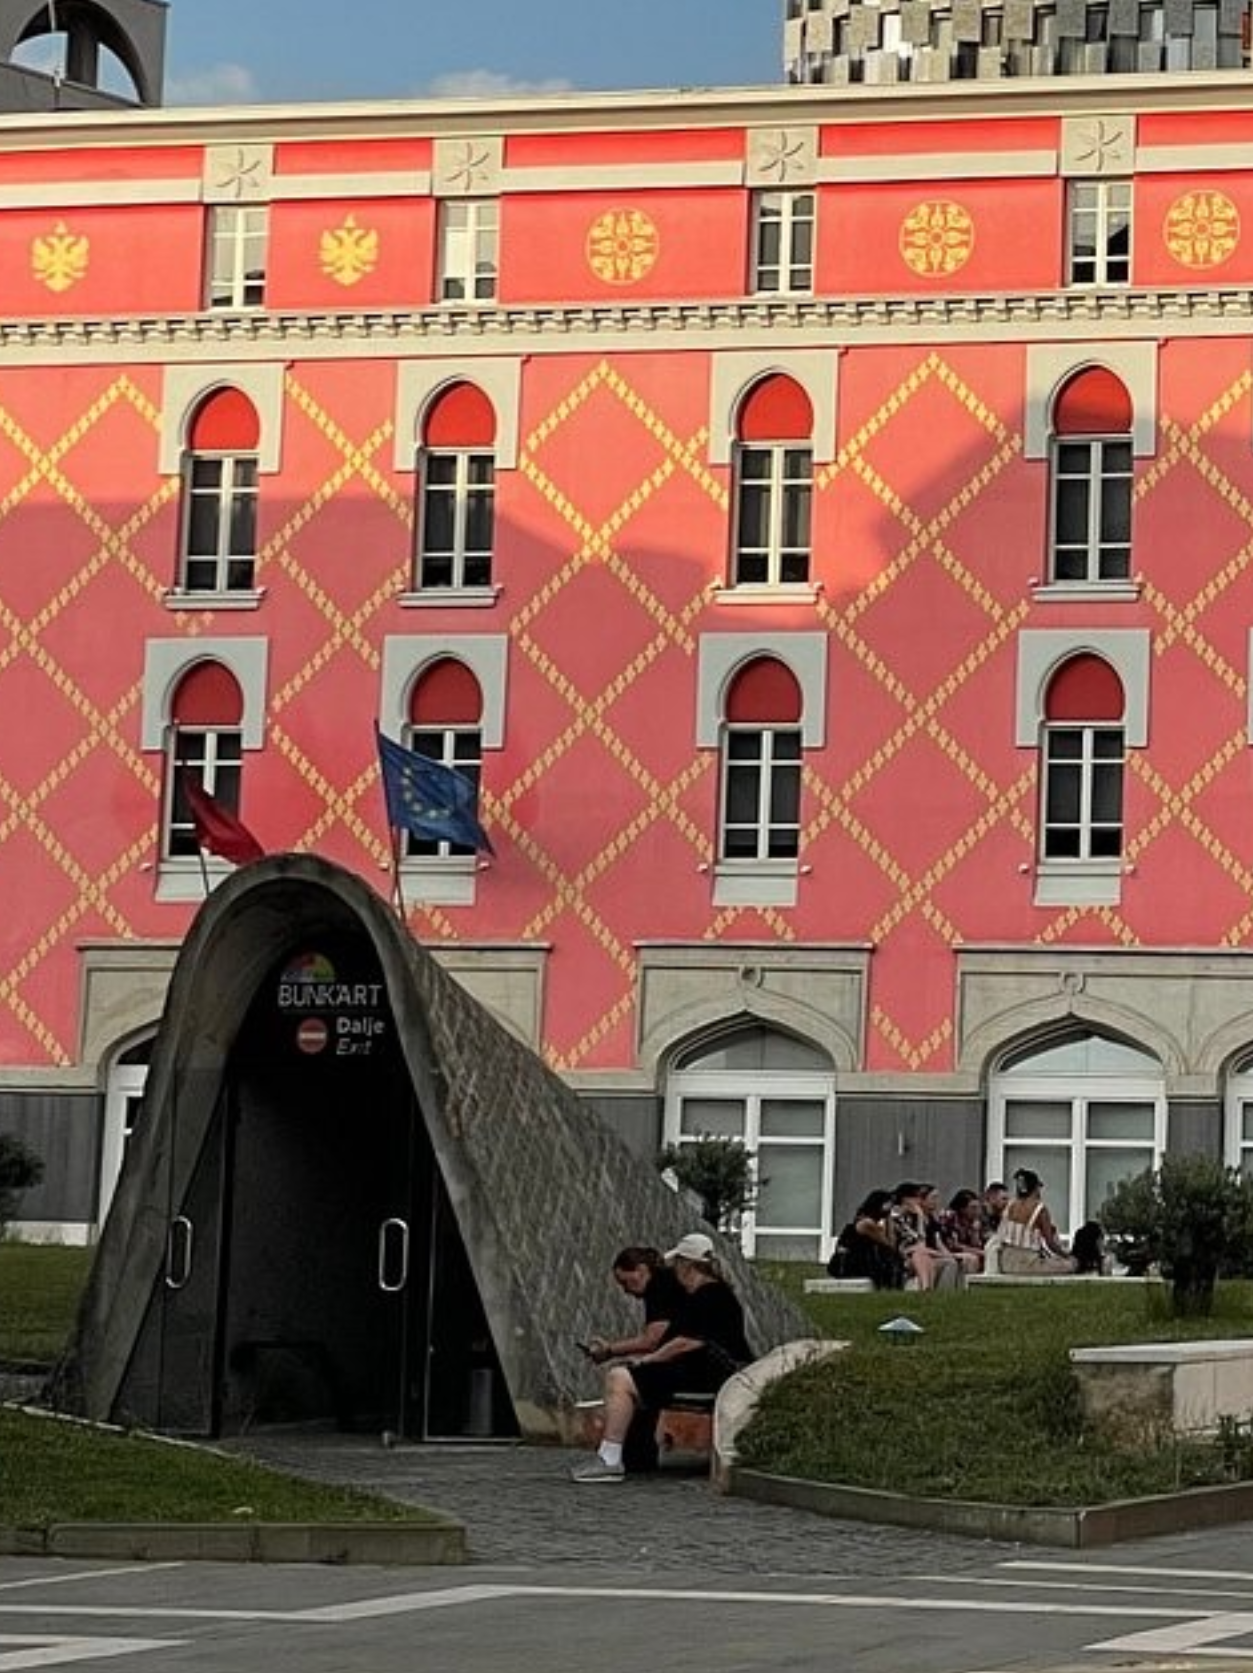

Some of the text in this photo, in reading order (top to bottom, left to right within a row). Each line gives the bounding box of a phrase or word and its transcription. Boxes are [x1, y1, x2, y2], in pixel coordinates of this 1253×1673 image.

[277, 984, 383, 1007] BUNK'ART
[335, 1016, 386, 1037] Dalje
[336, 1037, 372, 1056] Exit
